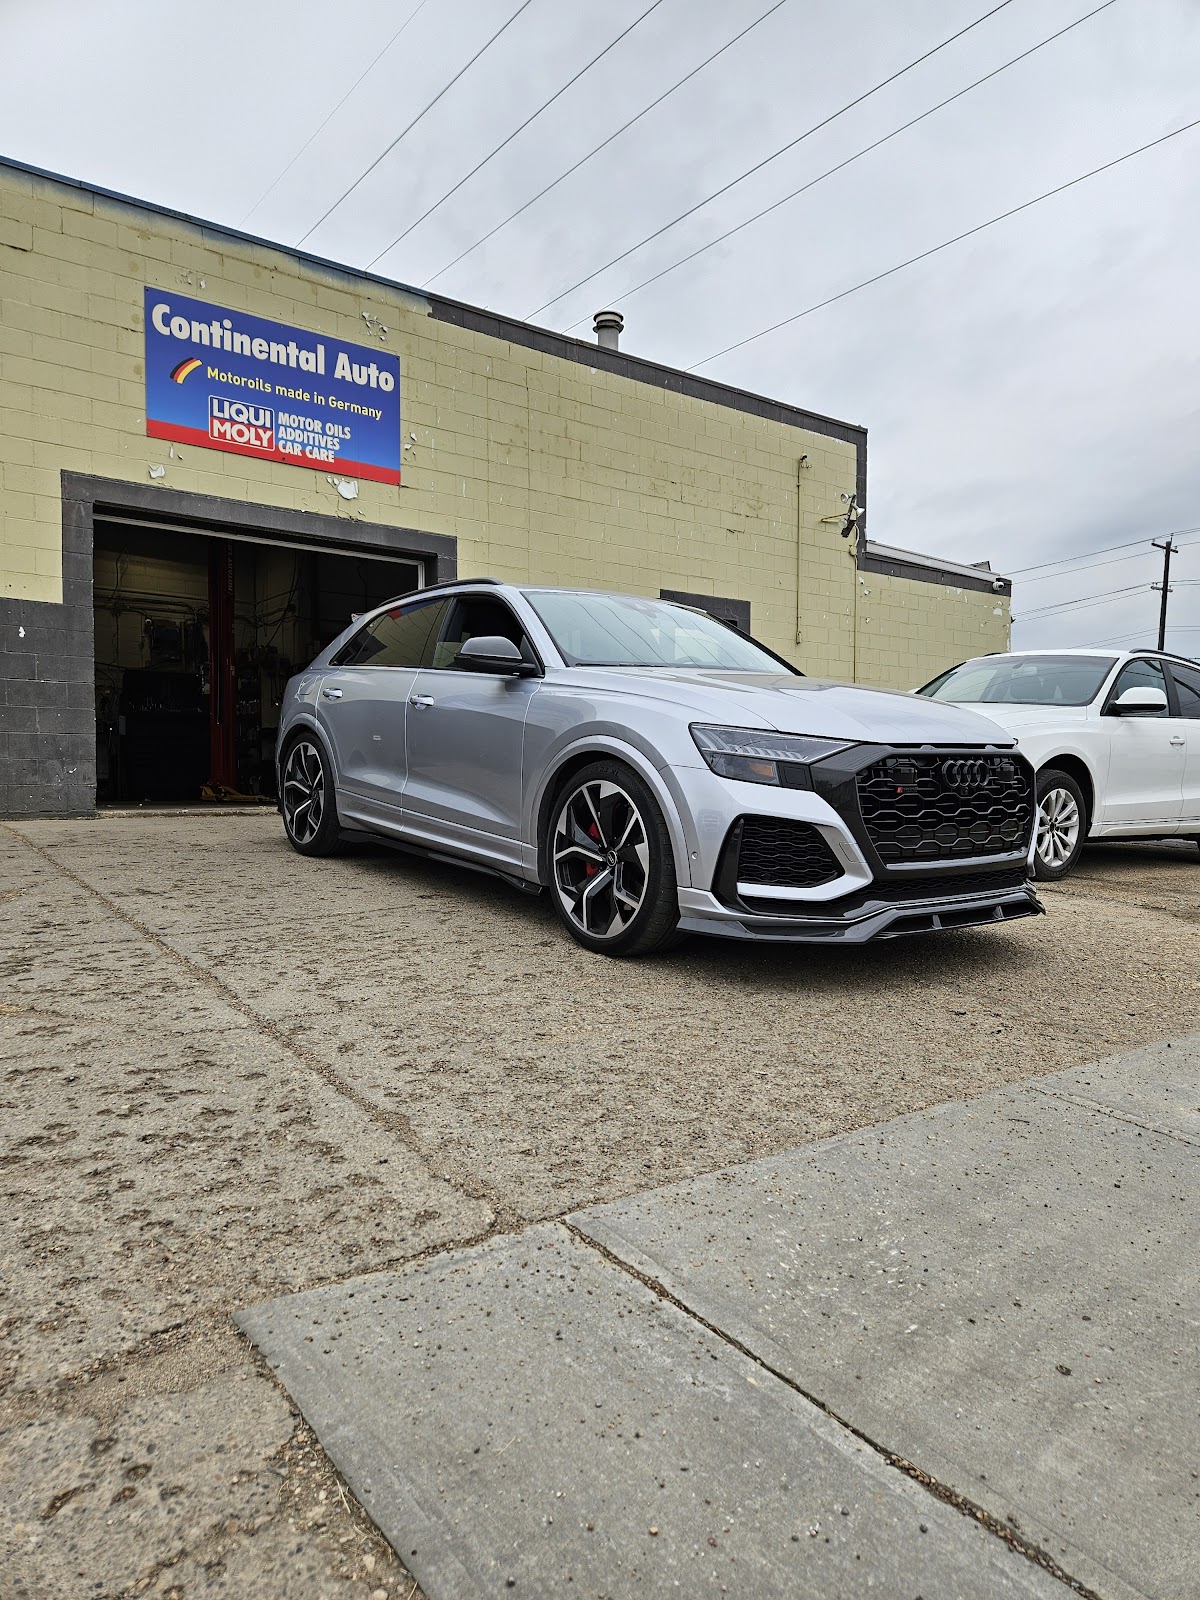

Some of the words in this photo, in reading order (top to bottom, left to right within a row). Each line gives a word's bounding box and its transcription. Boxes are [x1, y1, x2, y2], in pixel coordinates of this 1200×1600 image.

[152, 303, 325, 375] Continental
[334, 352, 395, 392] Auto
[207, 366, 272, 392] Motoroils
[275, 385, 310, 402] made
[313, 391, 325, 406] in
[328, 396, 382, 420] Germany
[212, 399, 271, 428] LIQUI
[278, 412, 322, 434] MOTOR
[325, 422, 351, 440] OILS
[212, 419, 273, 447] MOLY
[278, 426, 340, 451] ADDITIVES
[278, 440, 302, 457] CAR
[305, 446, 335, 463] CARE
